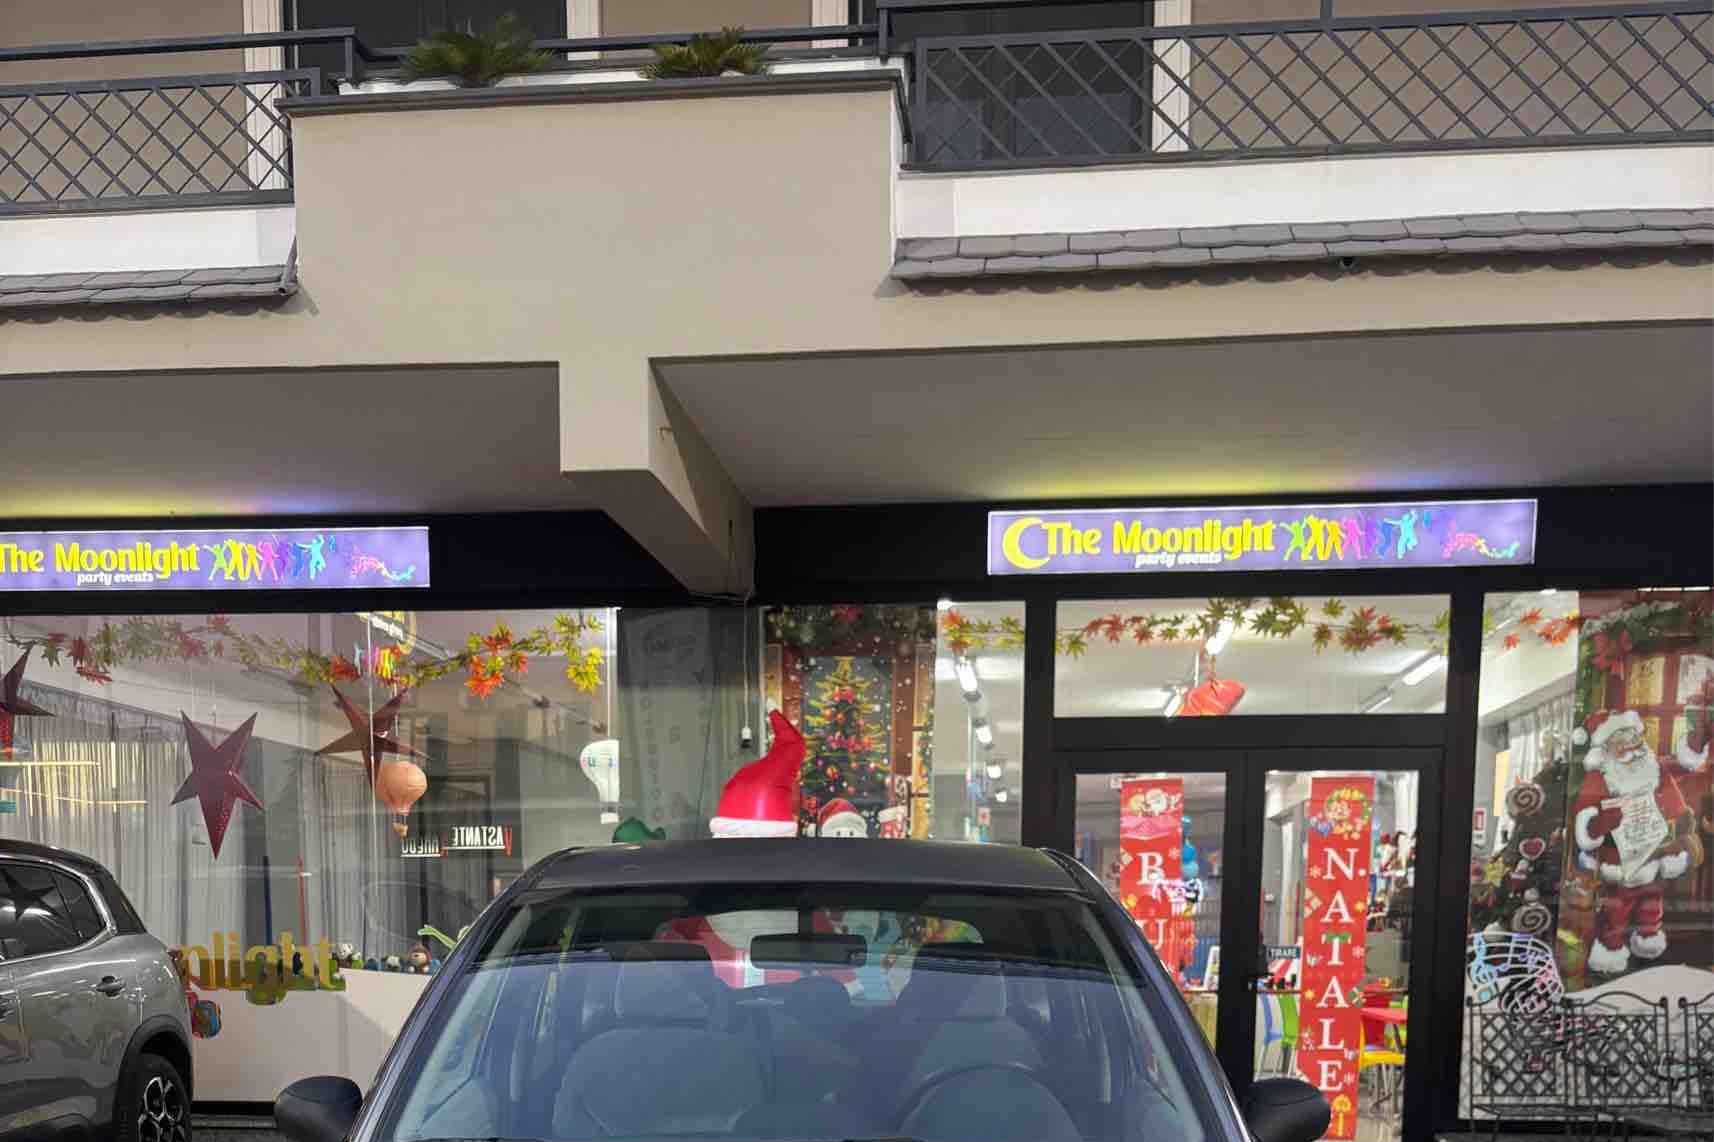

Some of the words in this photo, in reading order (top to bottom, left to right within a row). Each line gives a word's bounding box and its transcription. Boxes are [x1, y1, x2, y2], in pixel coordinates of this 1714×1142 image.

[0, 542, 45, 574] The
[54, 540, 200, 580] Moonlight
[1041, 519, 1102, 556] The
[1113, 518, 1276, 561] Moonlight
[1134, 552, 1176, 568] party
[1177, 552, 1222, 564] events
[76, 572, 112, 586] party
[113, 571, 154, 583] events
[182, 929, 345, 1005] nlight
[1316, 847, 1359, 1092] NATALE
